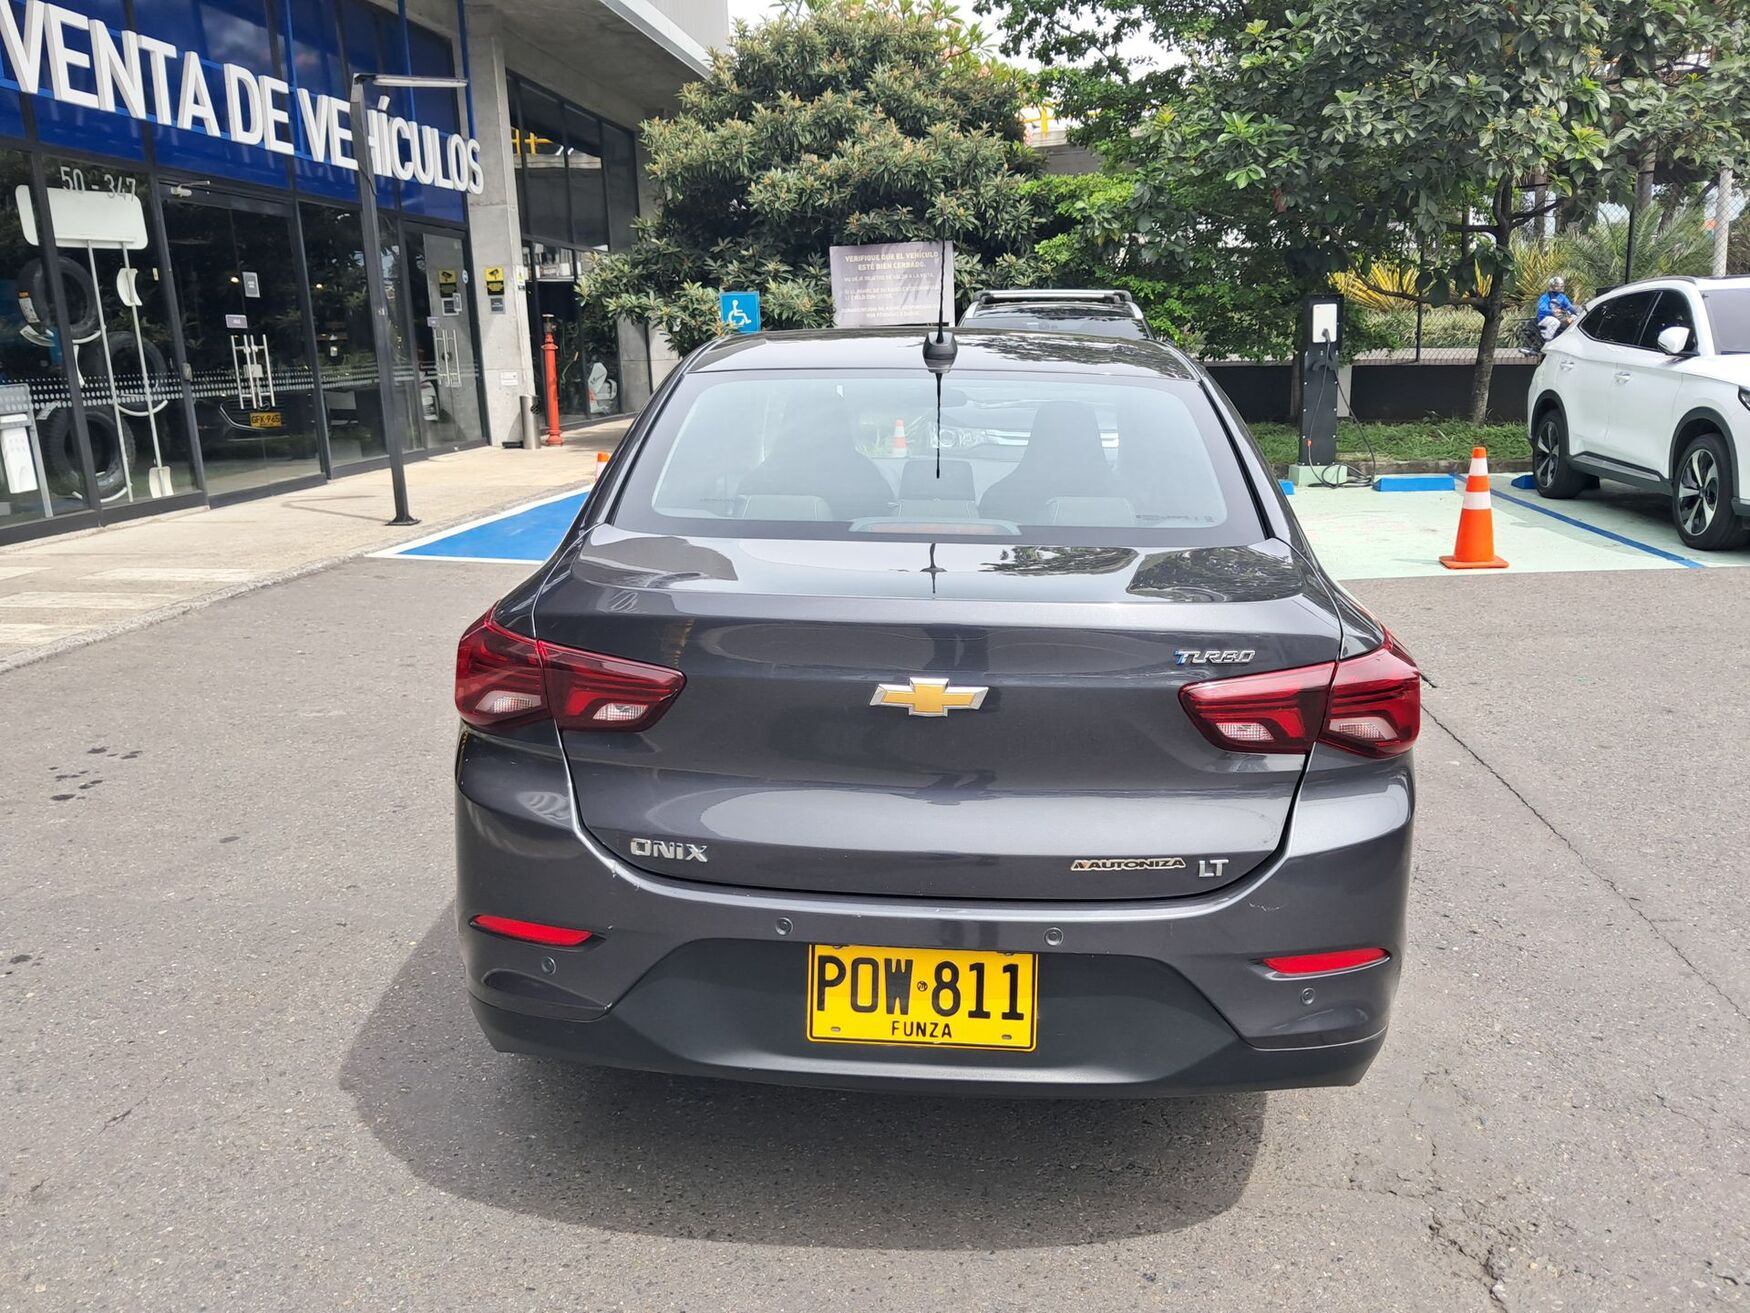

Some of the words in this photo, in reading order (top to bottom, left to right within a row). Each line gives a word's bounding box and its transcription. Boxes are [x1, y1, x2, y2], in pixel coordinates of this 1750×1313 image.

[0, 0, 222, 137] VENTA
[223, 62, 295, 156] DE
[297, 88, 484, 195] VEHÍCULOS
[60, 166, 86, 194] 50
[104, 173, 136, 203] 347
[1174, 649, 1256, 665] TURBO
[1088, 858, 1185, 870] AUTONIZA
[1198, 858, 1230, 878] LT
[816, 954, 914, 1016] POW
[931, 960, 1025, 1021] 811
[890, 1020, 952, 1039] FUNZA
